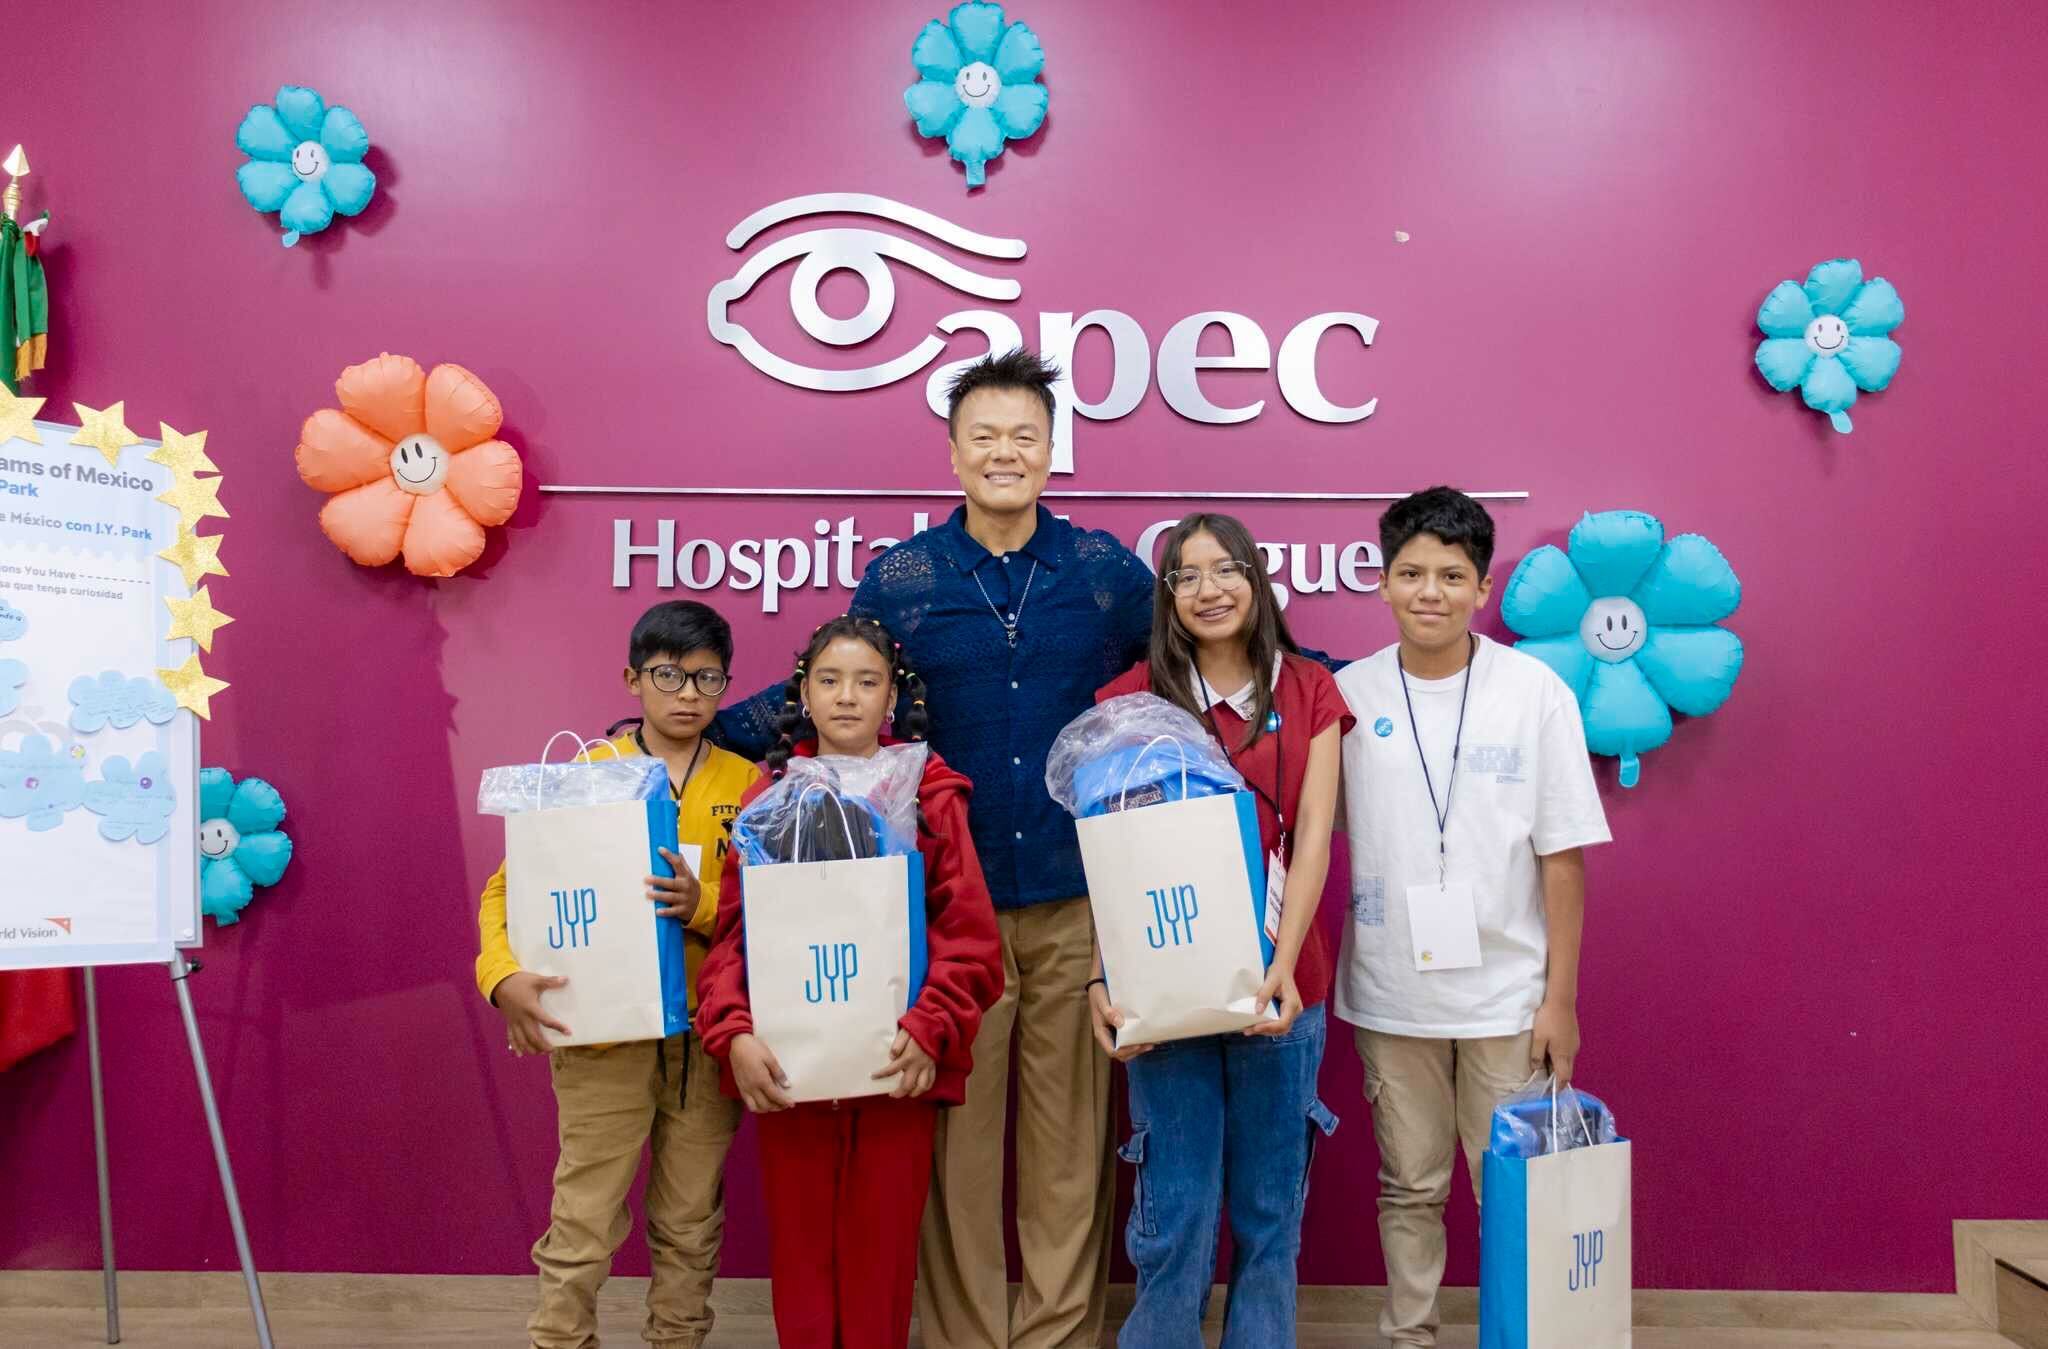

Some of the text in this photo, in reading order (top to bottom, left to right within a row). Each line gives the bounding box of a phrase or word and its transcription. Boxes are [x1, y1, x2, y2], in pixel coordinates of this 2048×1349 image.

[926, 309, 1380, 474] apec
[50, 463, 72, 479] of
[76, 465, 153, 491] Mexico
[10, 511, 62, 529] México
[66, 521, 92, 533] con
[96, 522, 118, 535] J.Y.
[121, 525, 152, 540] Park
[14, 582, 33, 592] que
[37, 583, 67, 596] tenga
[70, 587, 123, 600] curiosidad
[24, 566, 46, 577] You
[49, 569, 76, 580] Have
[612, 512, 1384, 613] Hospit Cgue
[20, 927, 58, 939] Vision
[548, 887, 597, 949] JYP
[1146, 884, 1199, 949] JYP
[805, 943, 858, 1003] JYP
[1568, 1230, 1603, 1291] JYP
